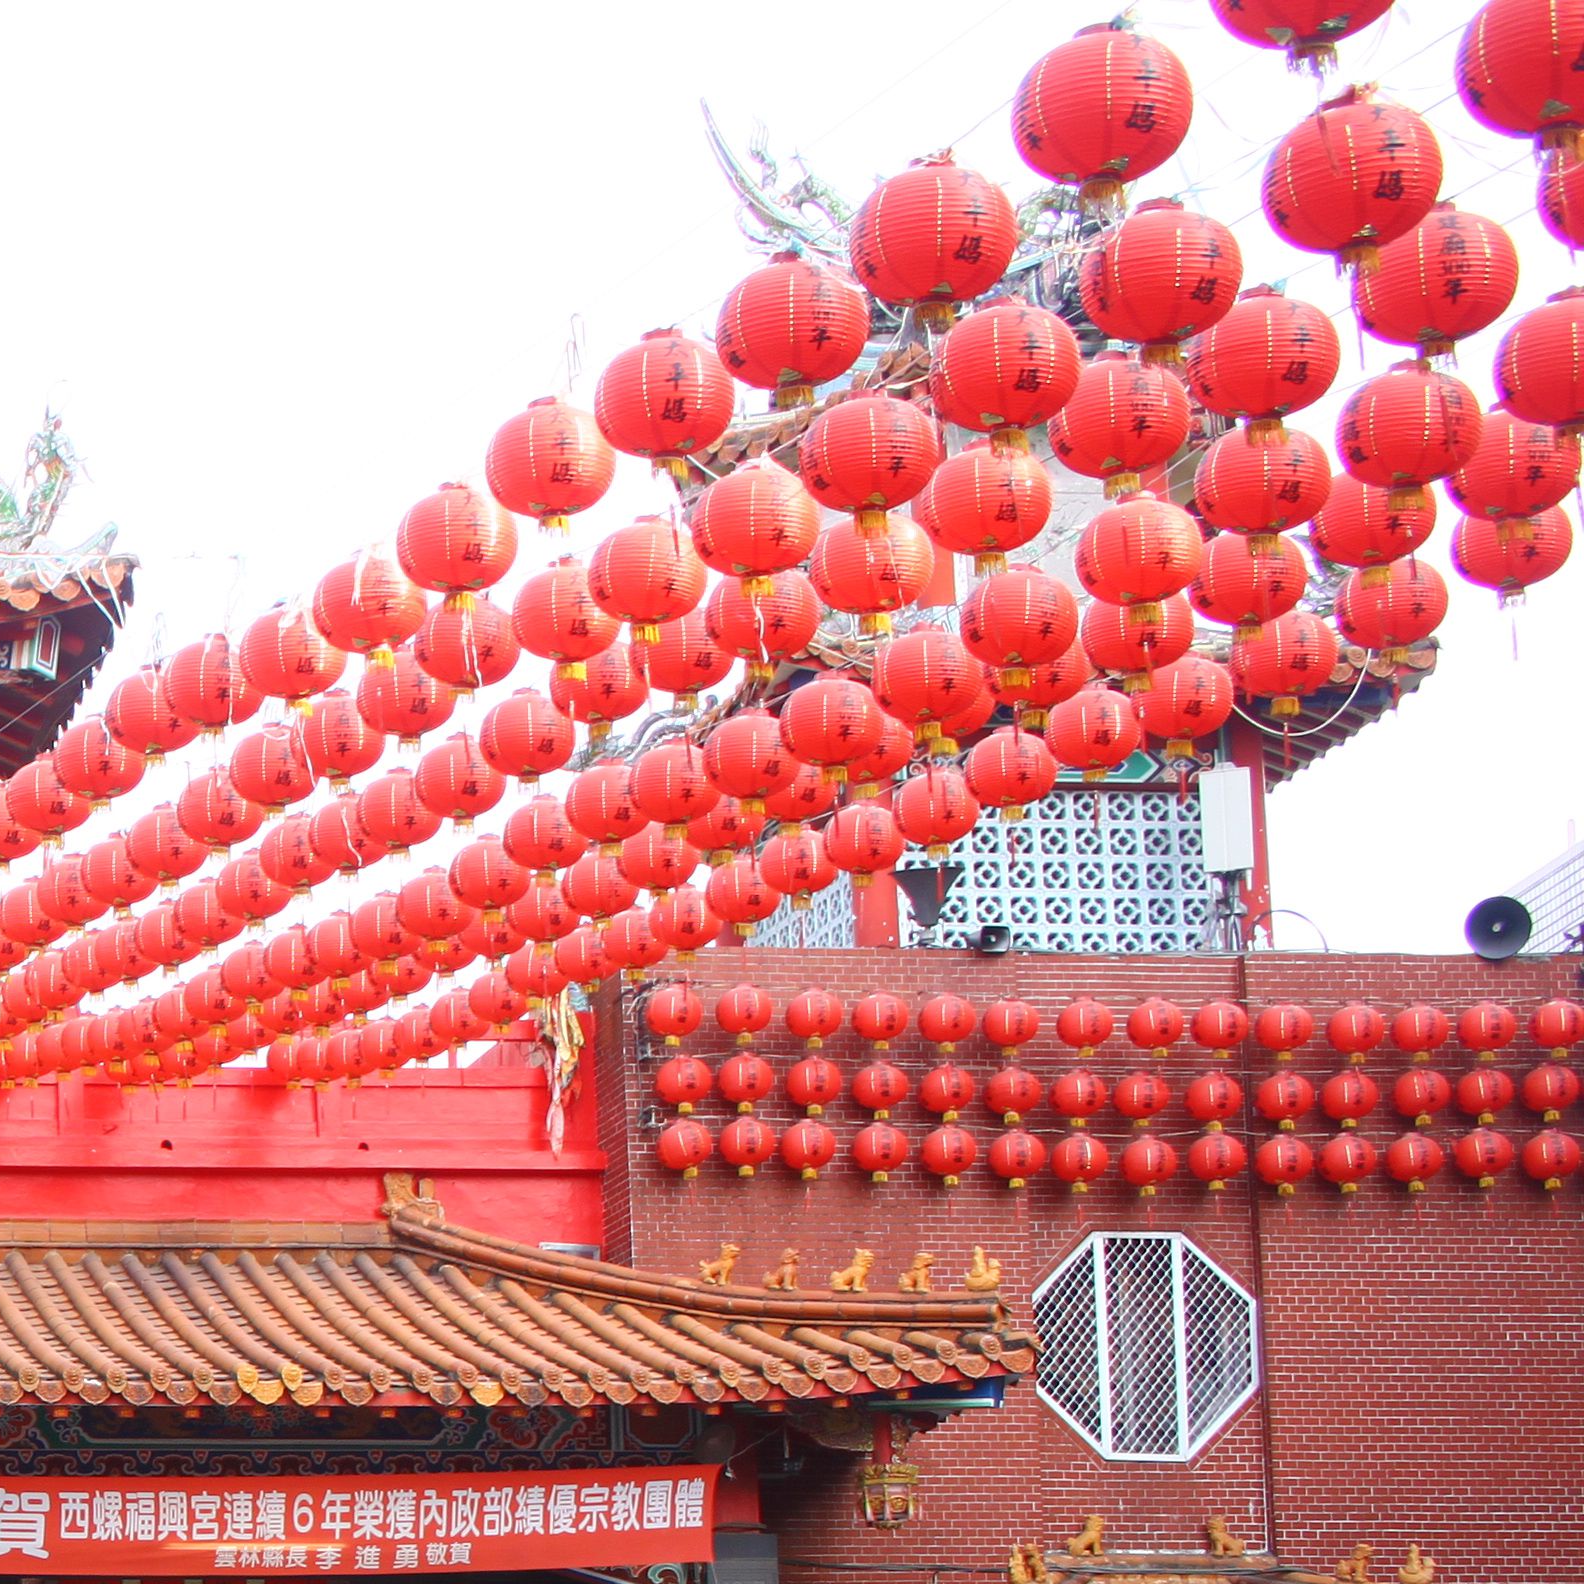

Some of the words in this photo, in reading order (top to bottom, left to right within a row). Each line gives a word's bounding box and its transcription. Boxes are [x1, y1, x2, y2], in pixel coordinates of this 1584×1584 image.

[58, 1478, 706, 1543] 西螺福興宮連續6年榮獲內政部績優宗教團體
[213, 1546, 308, 1569] 雲林縣長
[424, 1541, 472, 1566] 敬賀
